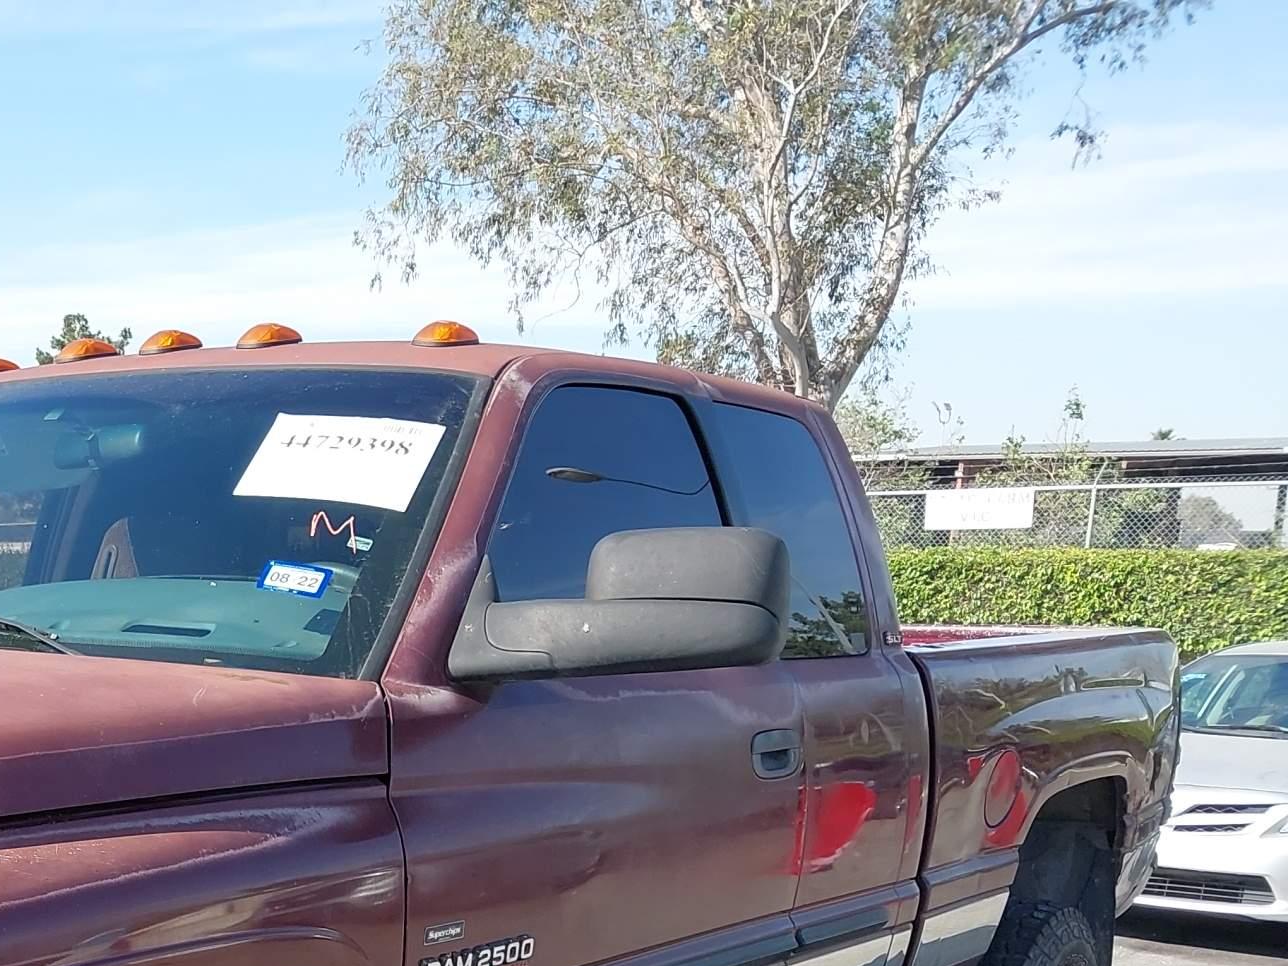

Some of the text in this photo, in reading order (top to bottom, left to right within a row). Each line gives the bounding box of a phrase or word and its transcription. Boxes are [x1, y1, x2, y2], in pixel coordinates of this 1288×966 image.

[280, 435, 413, 456] 44729398
[310, 511, 357, 554] M
[269, 570, 320, 588] 08 22
